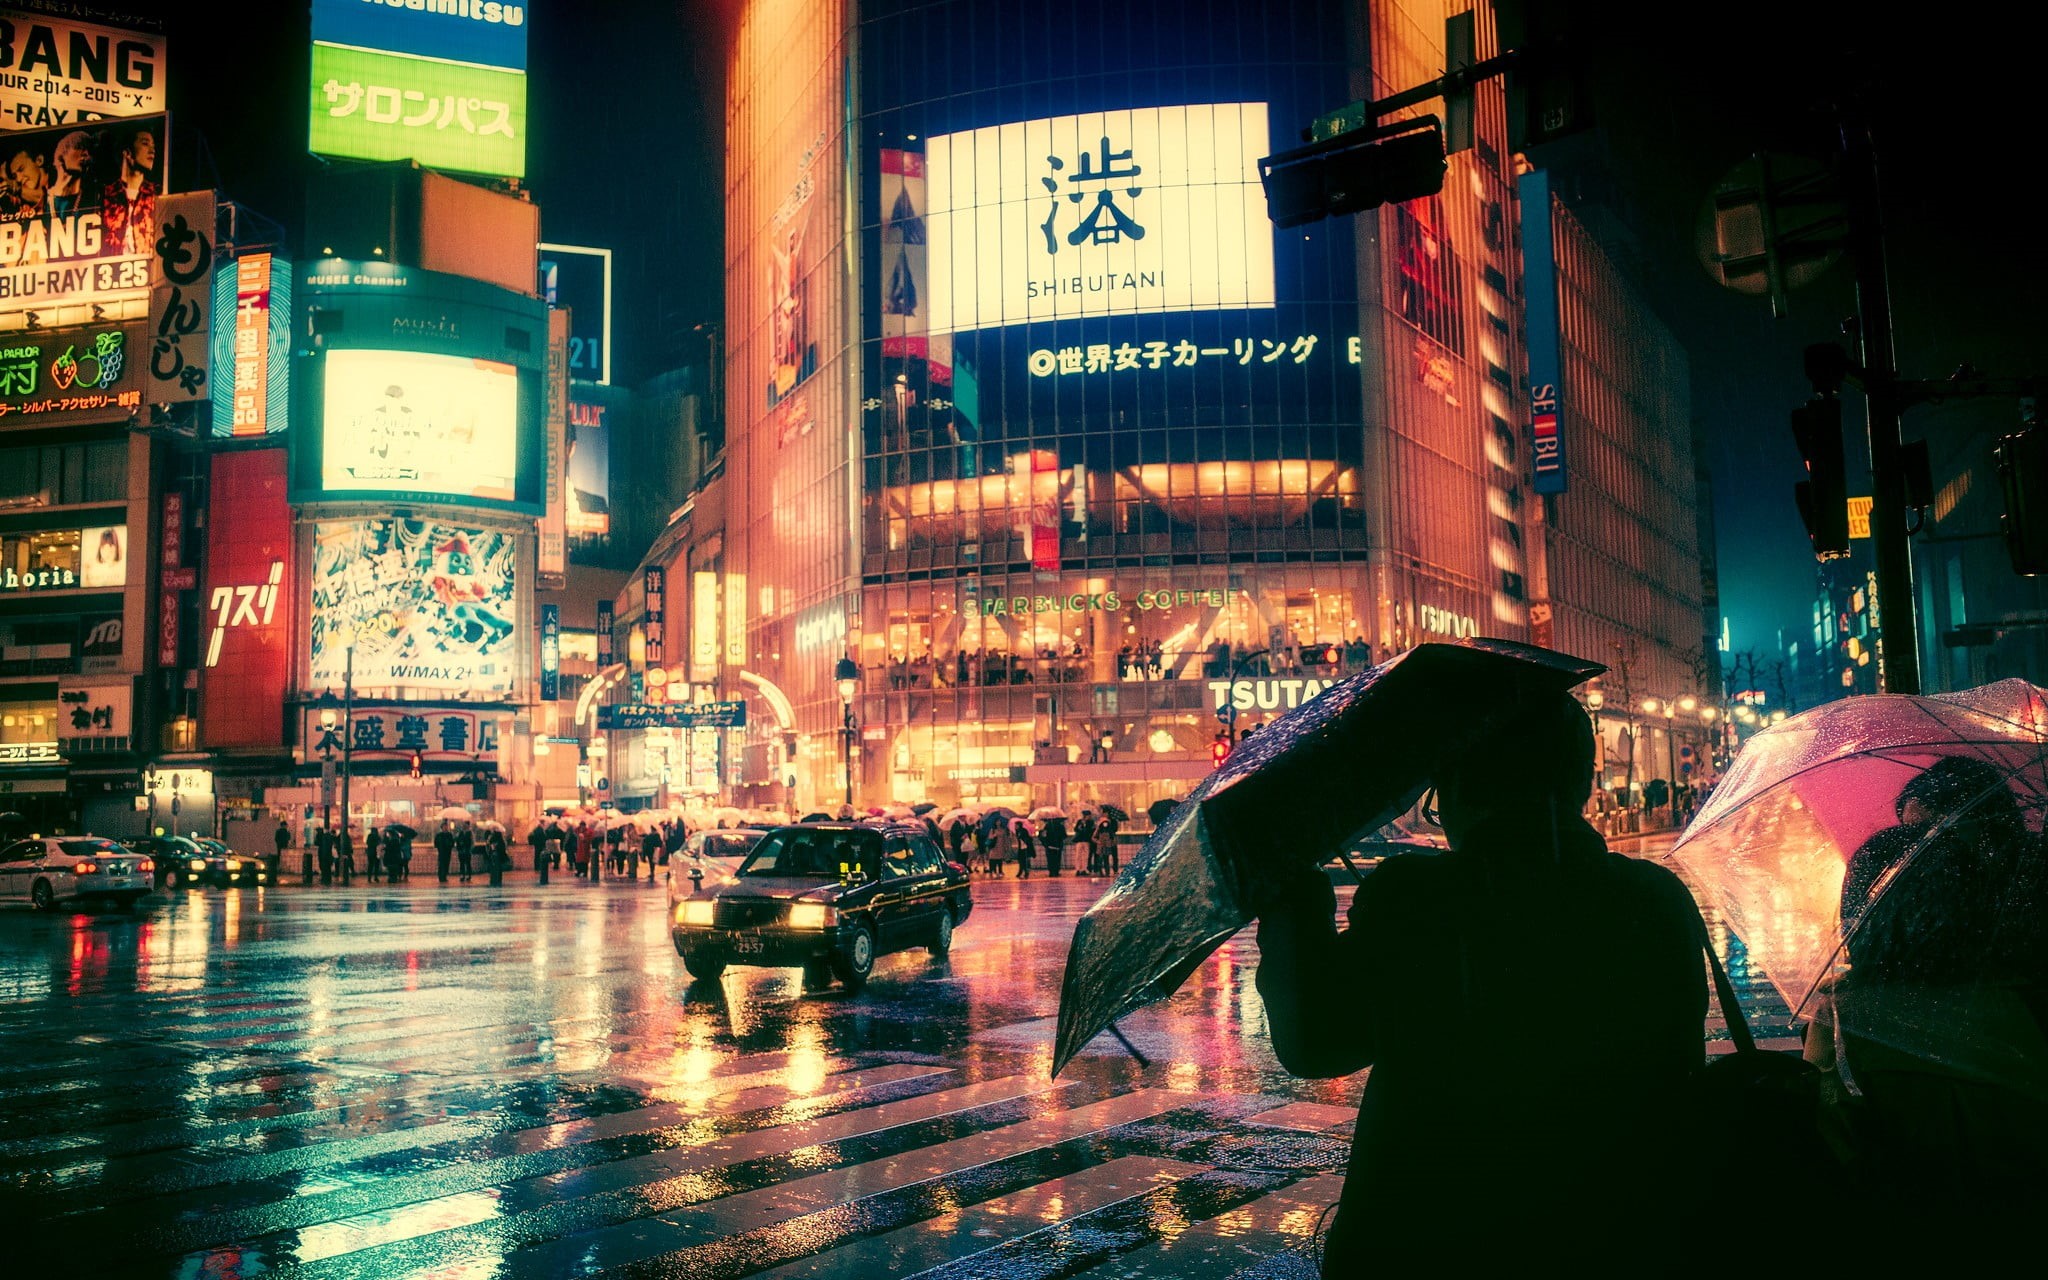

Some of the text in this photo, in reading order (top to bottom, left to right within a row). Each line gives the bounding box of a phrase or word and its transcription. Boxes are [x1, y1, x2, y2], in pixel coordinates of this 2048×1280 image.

[322, 78, 516, 139] サロンパス
[0, 260, 149, 299] BLU-RAY 3.25
[307, 275, 407, 287] MUSEE Channel
[1027, 270, 1166, 299] SHIBUTANI
[151, 214, 212, 397] もんじゃ
[3, 346, 40, 359] PARLOR
[232, 261, 266, 425] 三千里薬品
[1532, 384, 1559, 472] SEIBU
[0, 565, 75, 588] horia
[963, 586, 1240, 620] STARBUCKS COFFEE
[84, 619, 123, 649] JTB
[391, 664, 452, 680] WiMAX
[455, 667, 475, 681] 2+
[315, 715, 499, 751] 大盛堂書店
[0, 747, 57, 758] ーツパーラー
